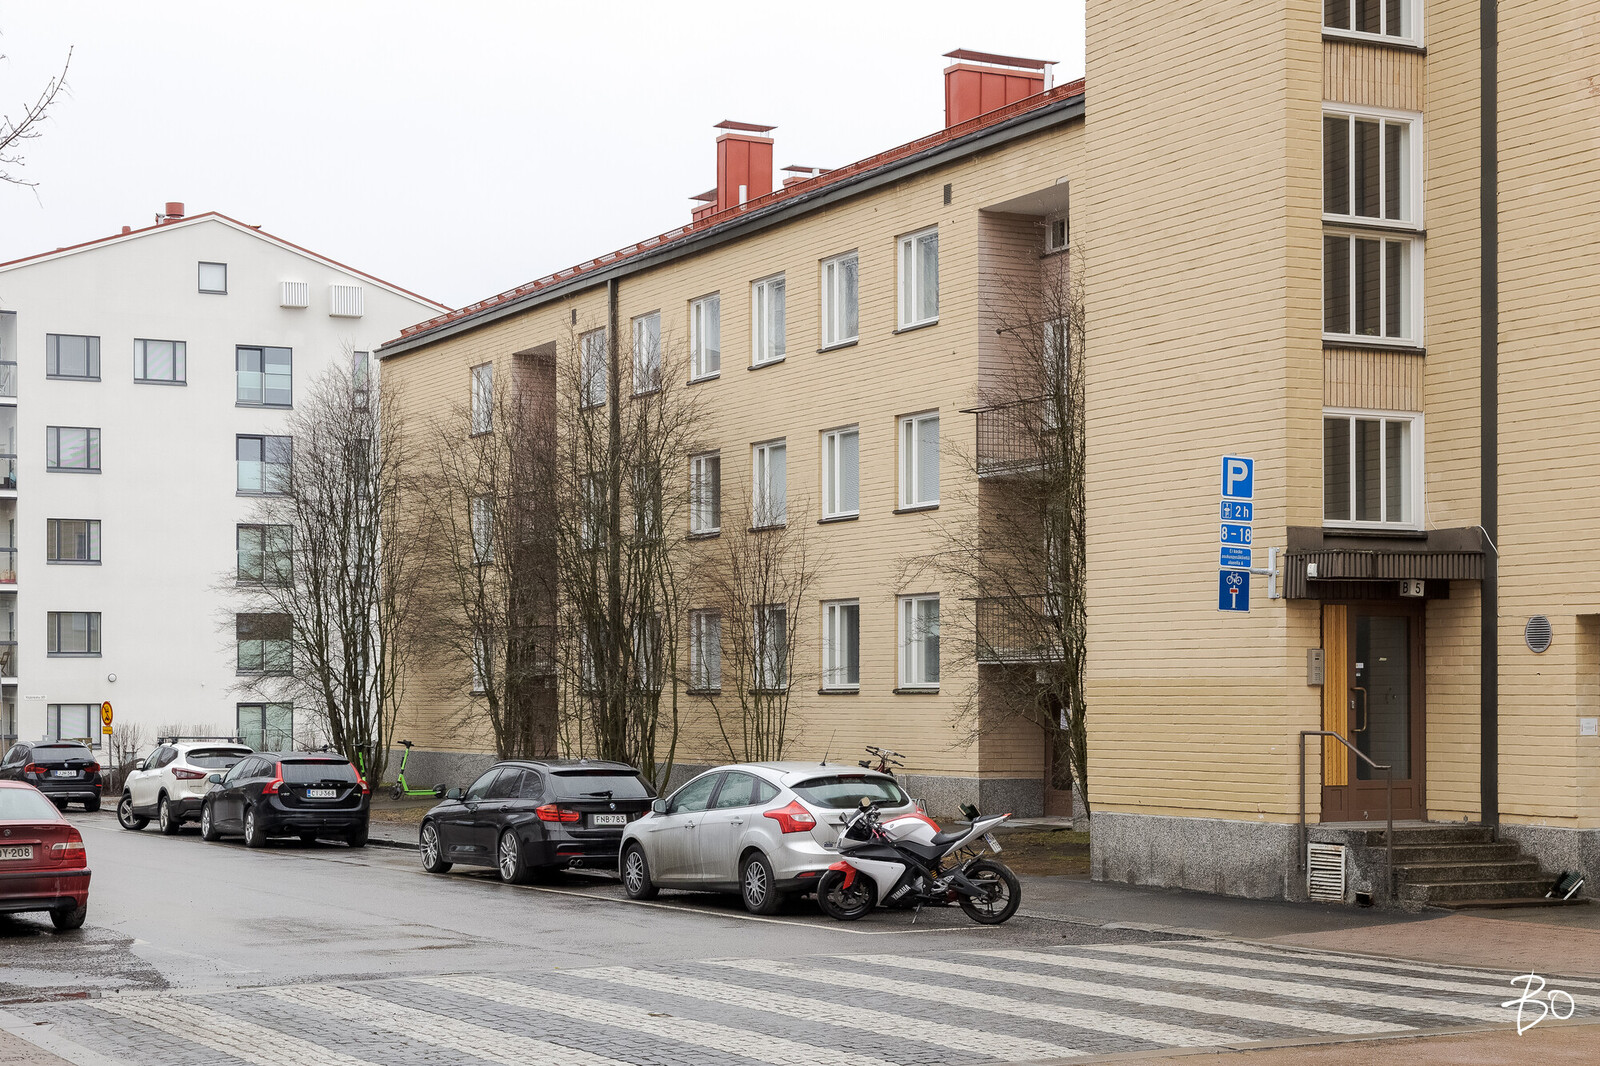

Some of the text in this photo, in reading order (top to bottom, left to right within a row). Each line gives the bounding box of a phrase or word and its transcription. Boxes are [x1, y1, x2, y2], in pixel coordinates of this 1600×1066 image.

[1227, 460, 1248, 495] P
[1235, 505, 1249, 518] 2 h
[1403, 582, 1421, 594] B 5
[595, 815, 625, 823] FNB-783
[891, 885, 911, 900] YAMAHA
